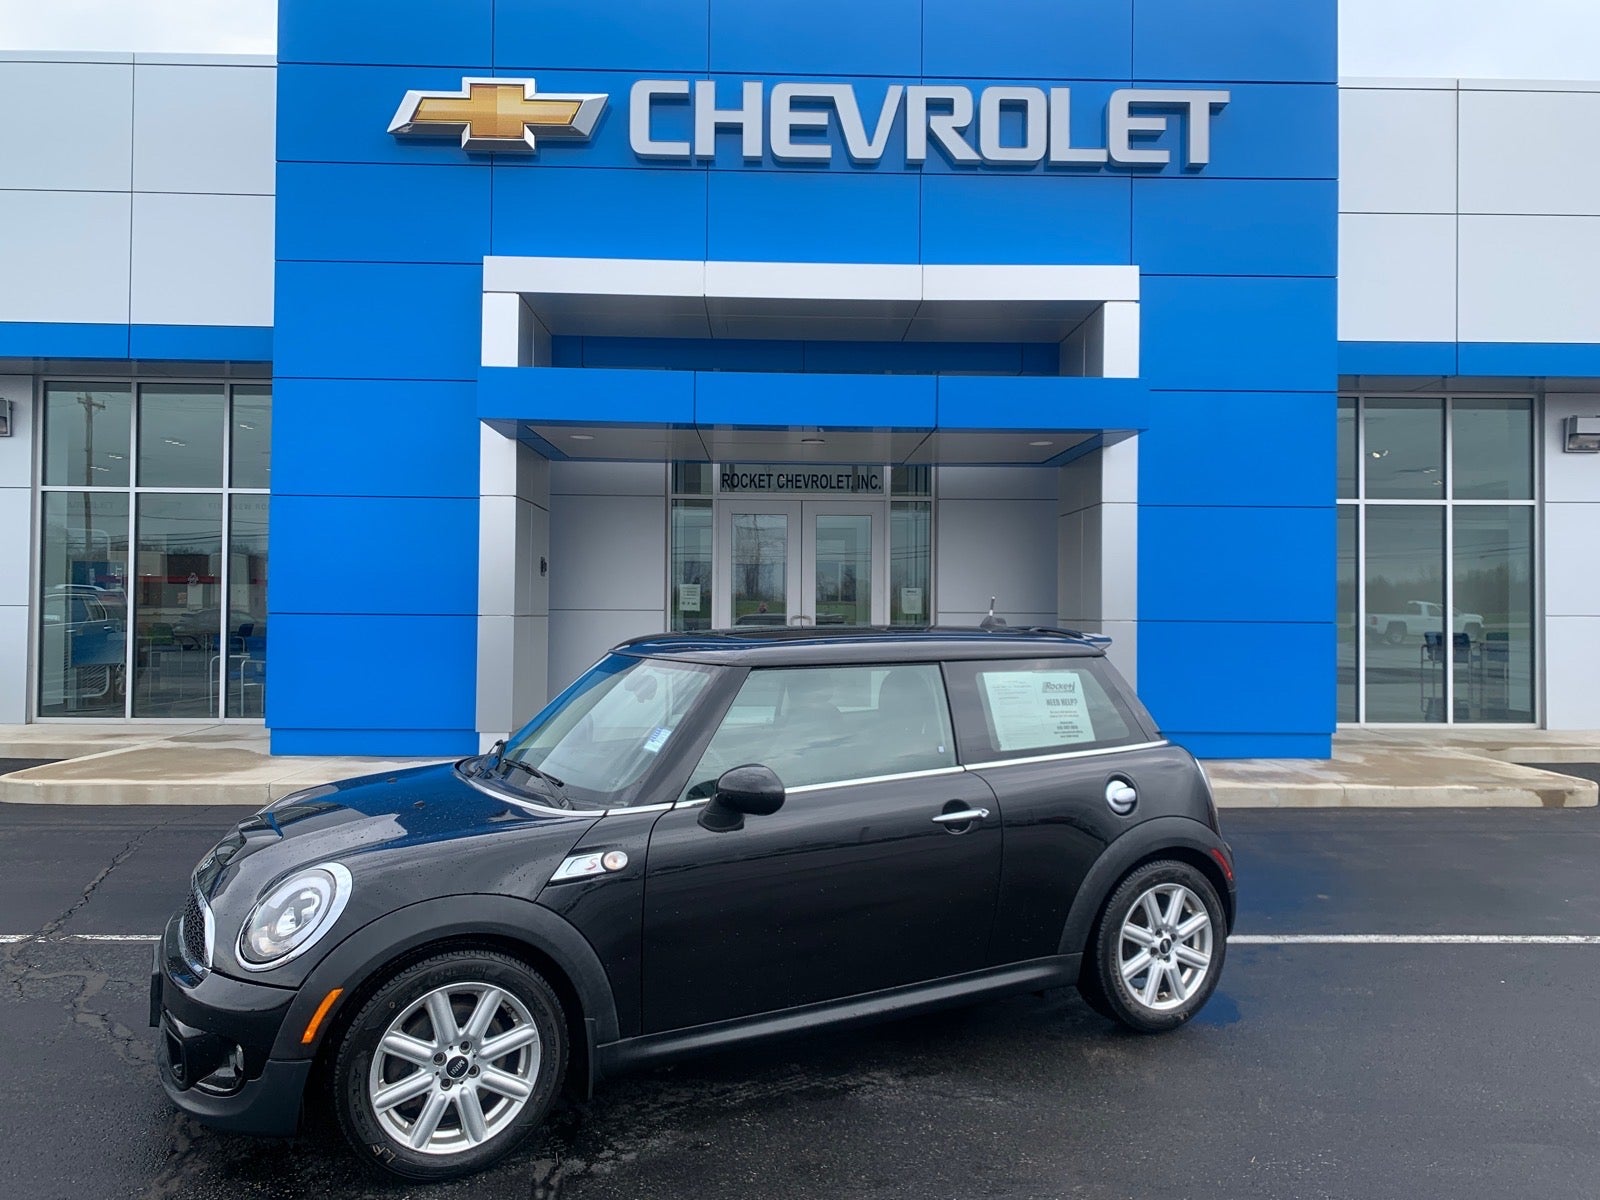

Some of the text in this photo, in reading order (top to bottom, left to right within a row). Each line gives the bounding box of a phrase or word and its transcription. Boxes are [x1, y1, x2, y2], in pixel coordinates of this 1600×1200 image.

[629, 79, 1231, 166] CHEVROLET
[721, 473, 774, 489] ROCKET
[857, 474, 882, 490] INC.
[1045, 681, 1074, 690] Rocket
[1046, 698, 1078, 706] NEED HELP?
[584, 857, 599, 871] S
[450, 1059, 466, 1076] MINI
